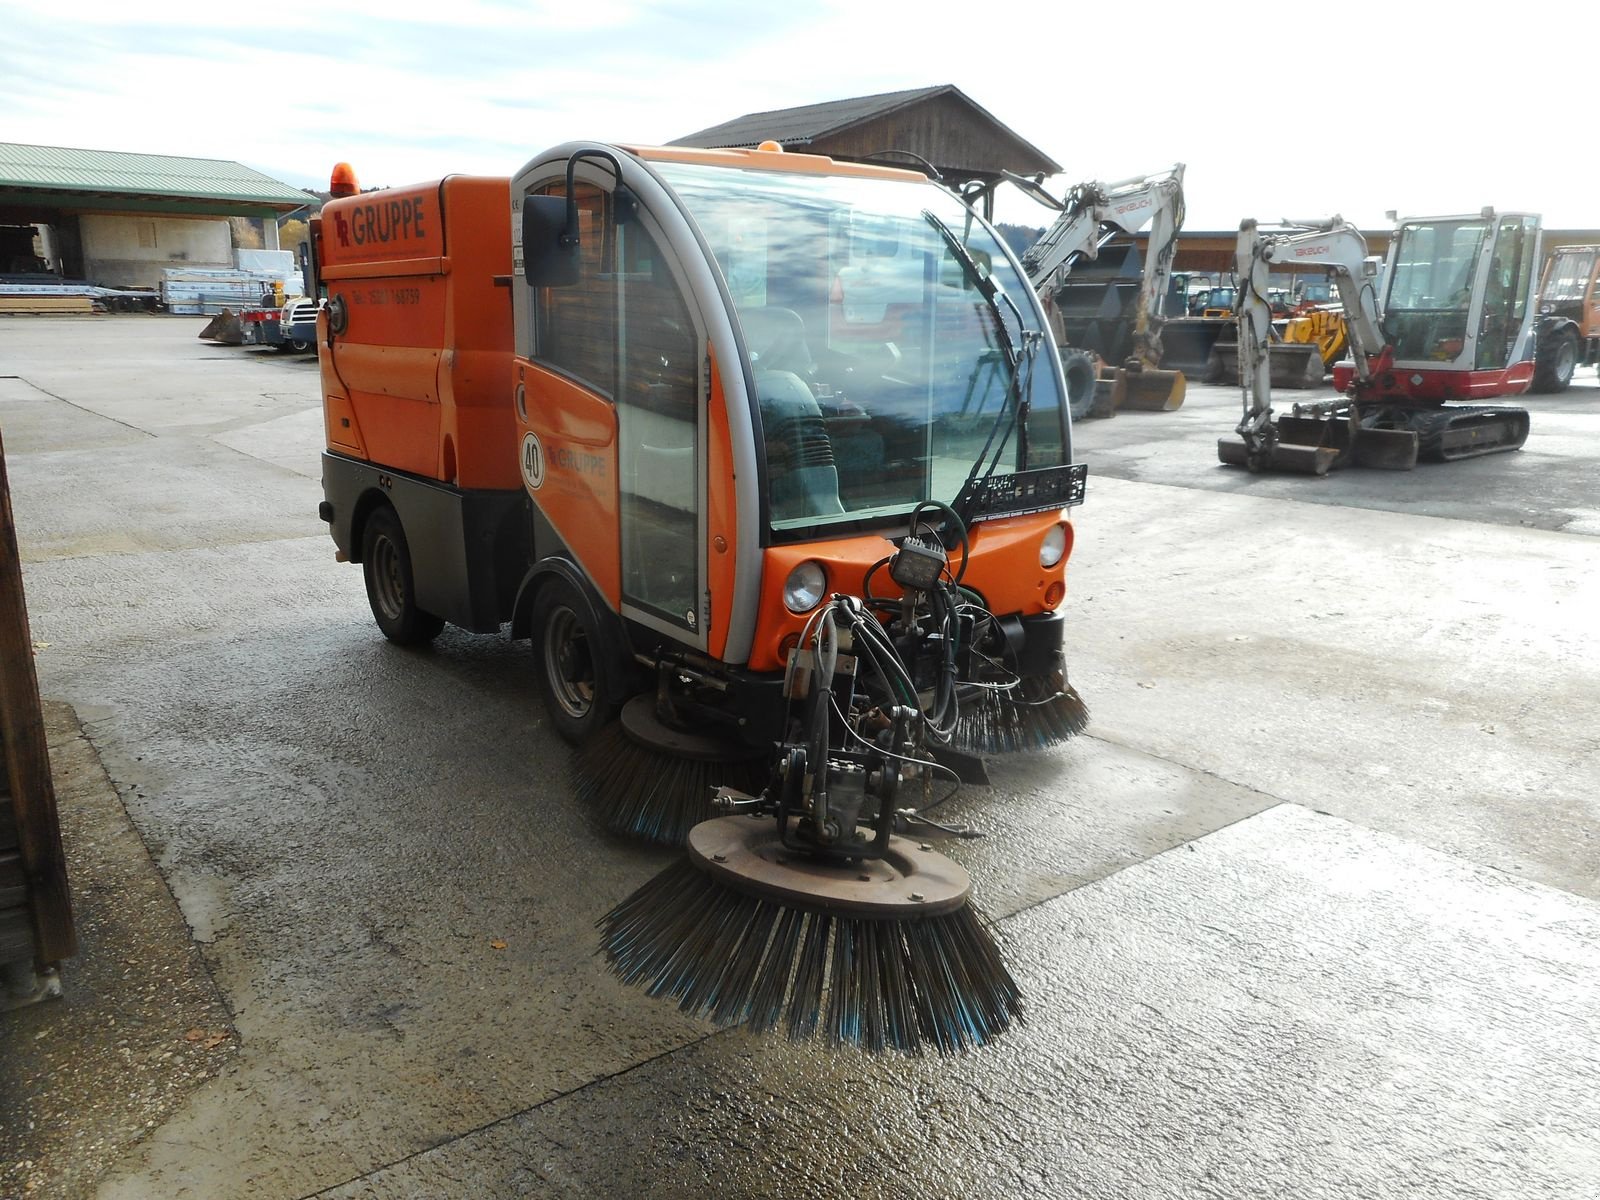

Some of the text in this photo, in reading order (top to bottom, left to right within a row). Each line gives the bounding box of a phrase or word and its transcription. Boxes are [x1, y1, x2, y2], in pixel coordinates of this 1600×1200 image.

[352, 197, 425, 245] GRUPPE
[525, 443, 539, 479] 40
[558, 448, 605, 477] GRUPPE
